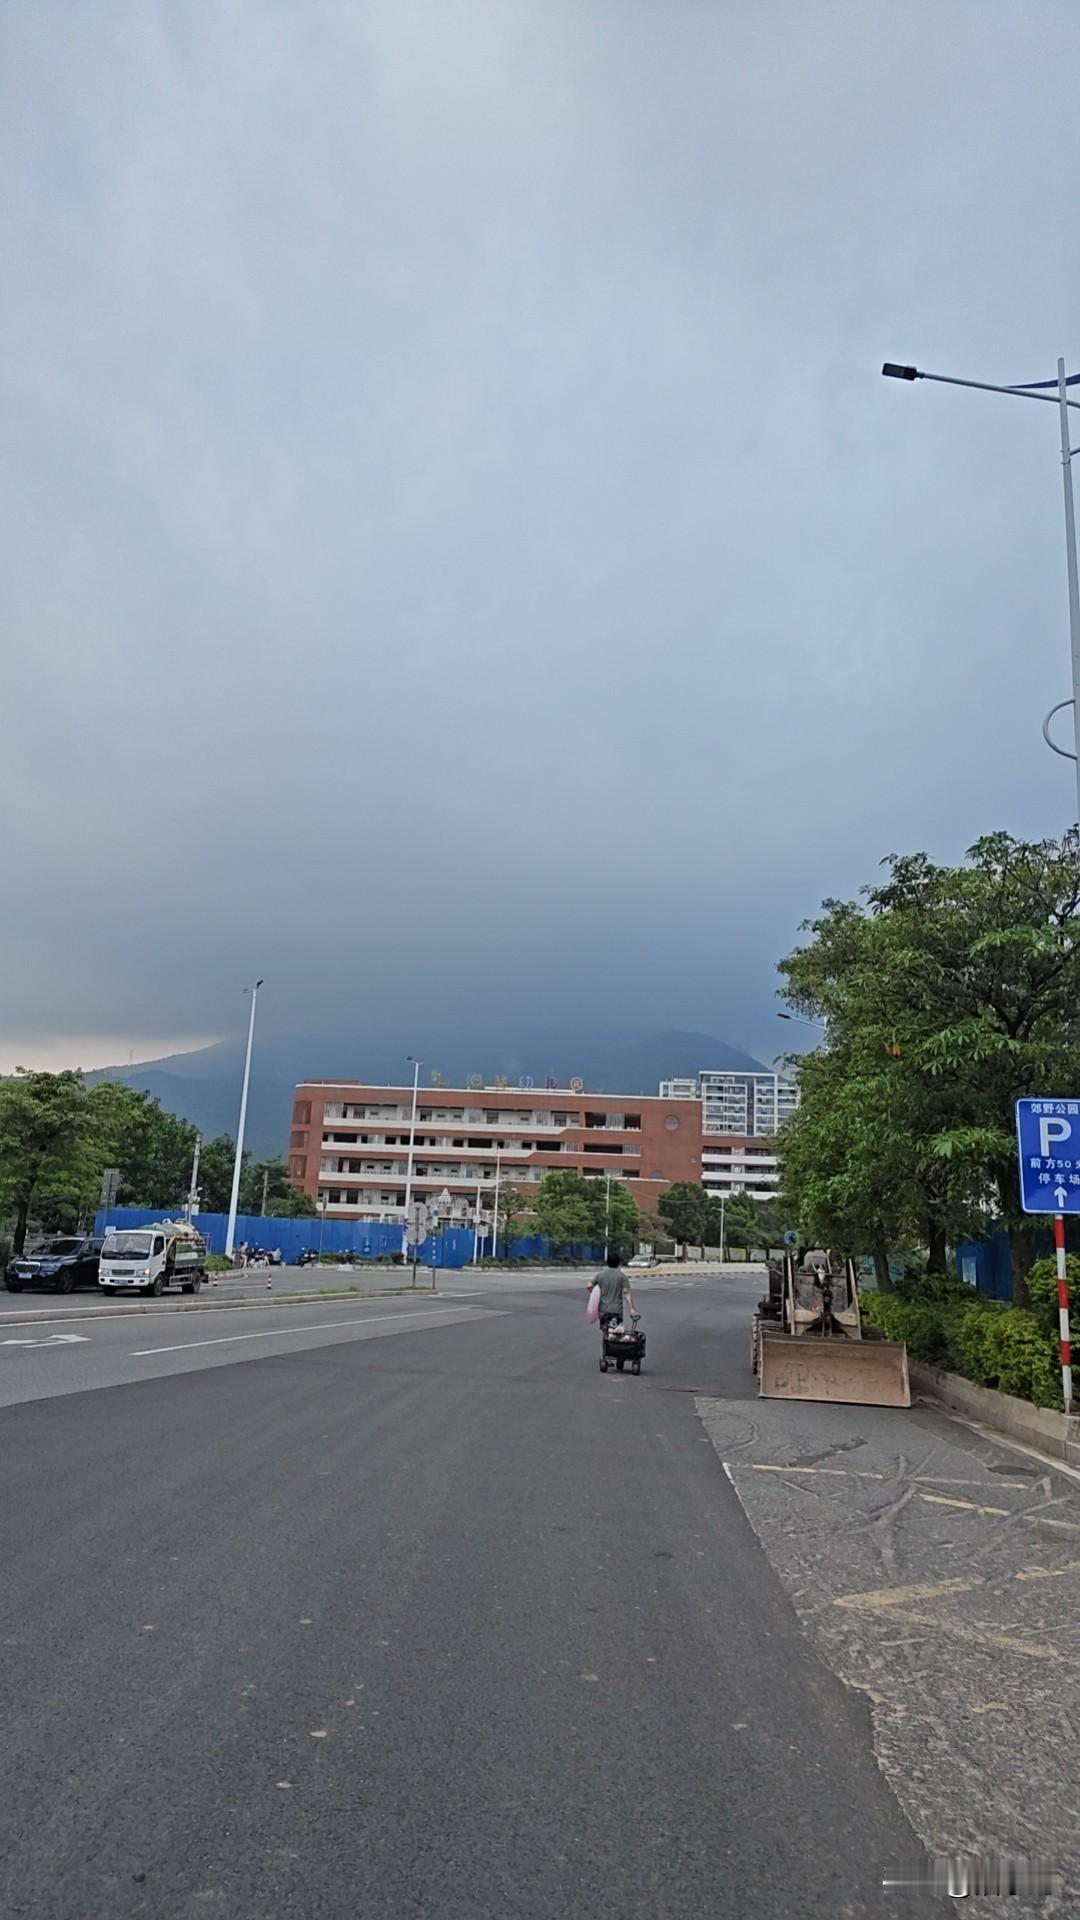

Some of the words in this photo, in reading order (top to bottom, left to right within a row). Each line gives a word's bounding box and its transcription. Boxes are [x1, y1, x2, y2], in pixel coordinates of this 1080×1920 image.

[1031, 1103, 1079, 1114] 郊野公园
[1040, 1117, 1071, 1157] P
